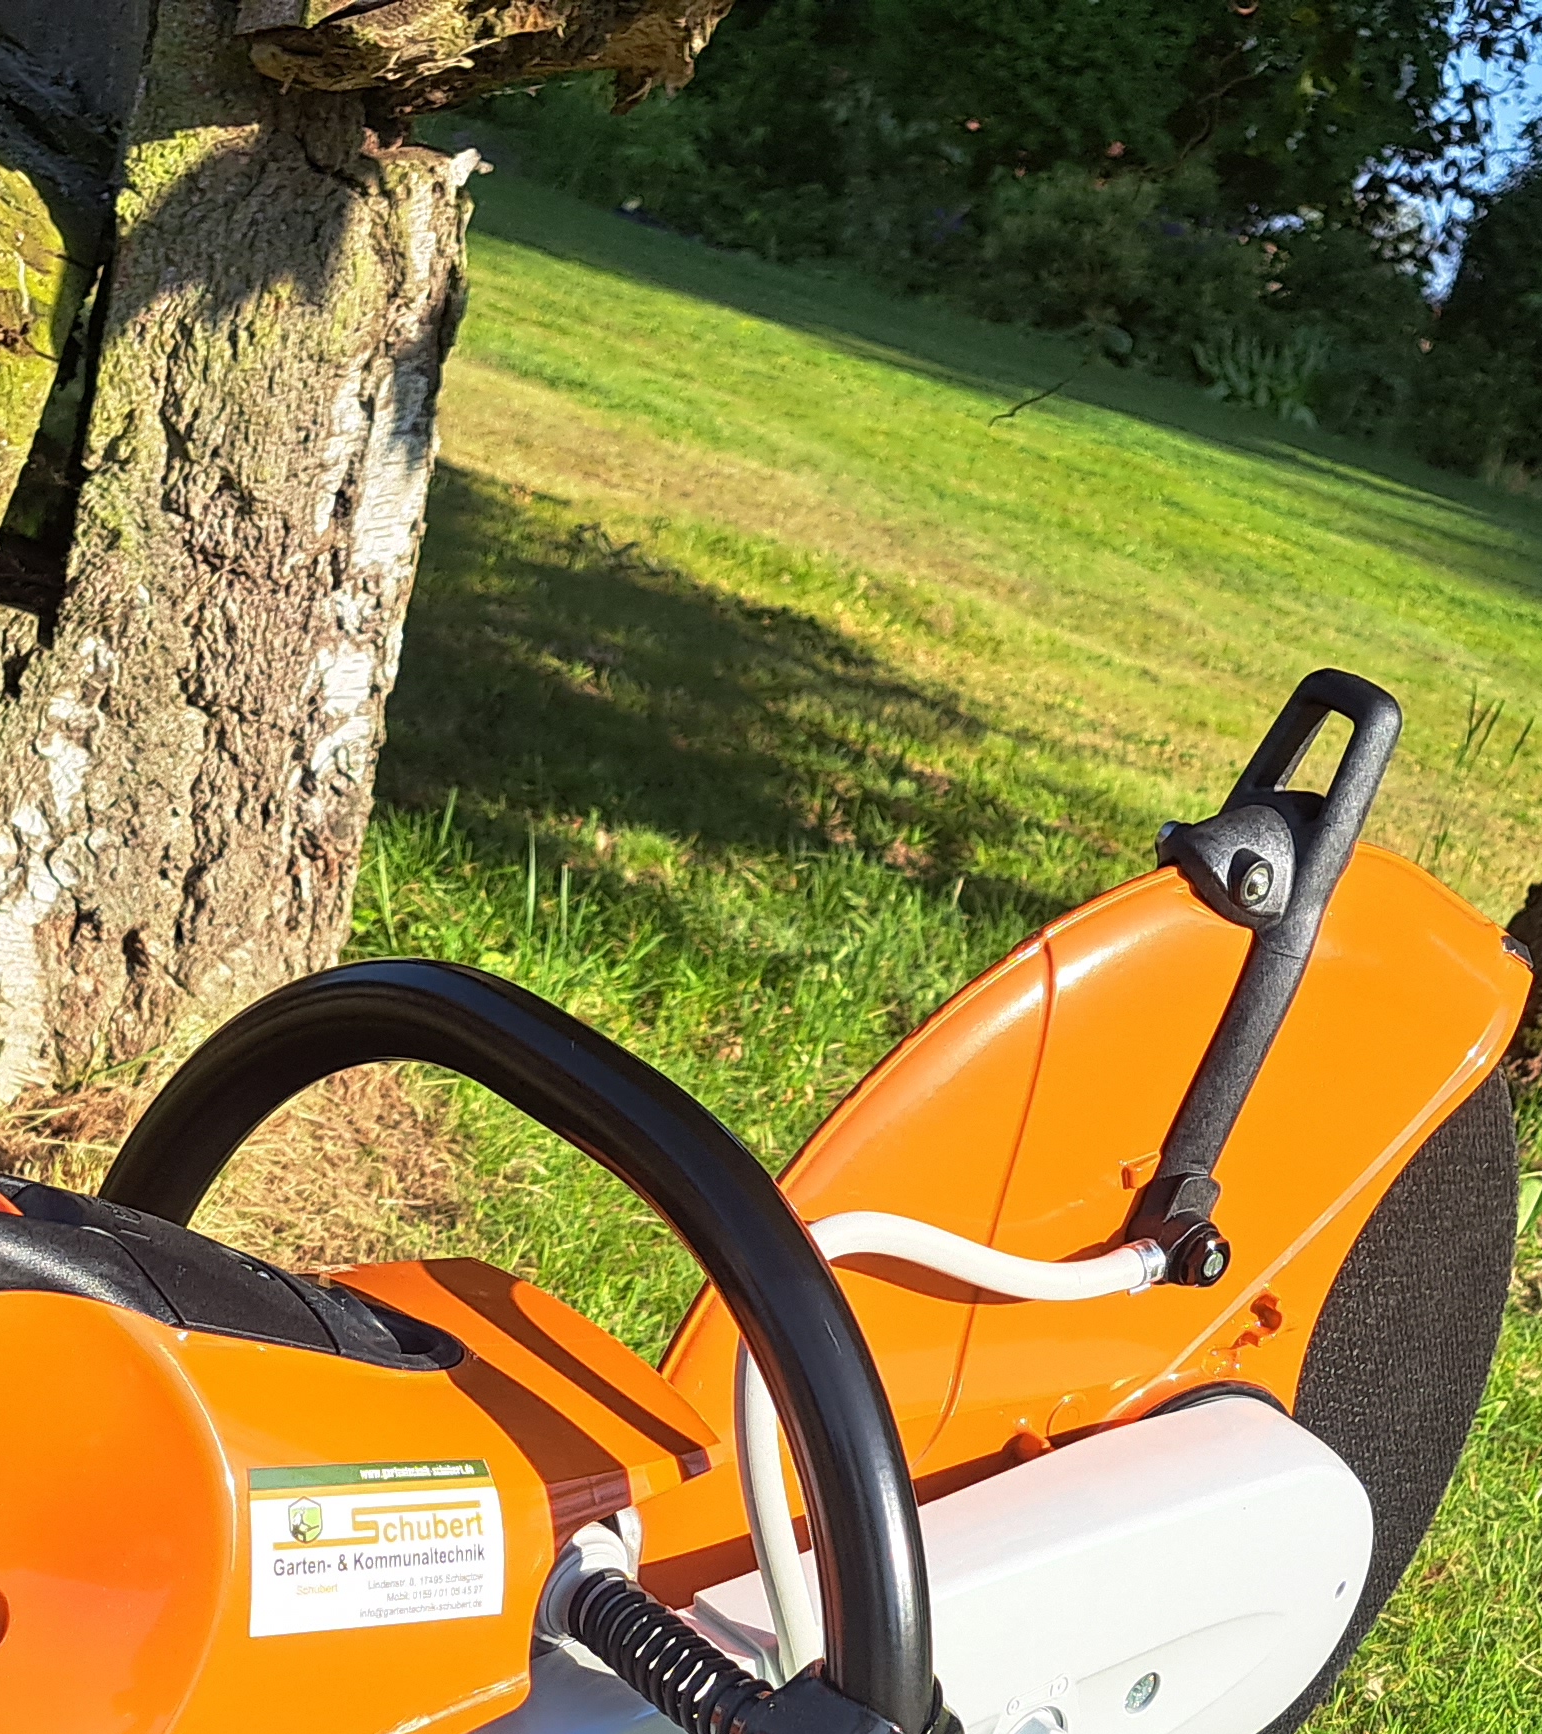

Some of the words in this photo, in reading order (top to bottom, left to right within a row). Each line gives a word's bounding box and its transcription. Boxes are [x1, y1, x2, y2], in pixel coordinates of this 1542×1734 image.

[351, 1500, 484, 1545] Schubert
[273, 1557, 332, 1576] Garten-
[337, 1553, 349, 1572] &
[353, 1543, 486, 1571] Kommunaltechnik
[296, 1583, 339, 1595] Schubert
